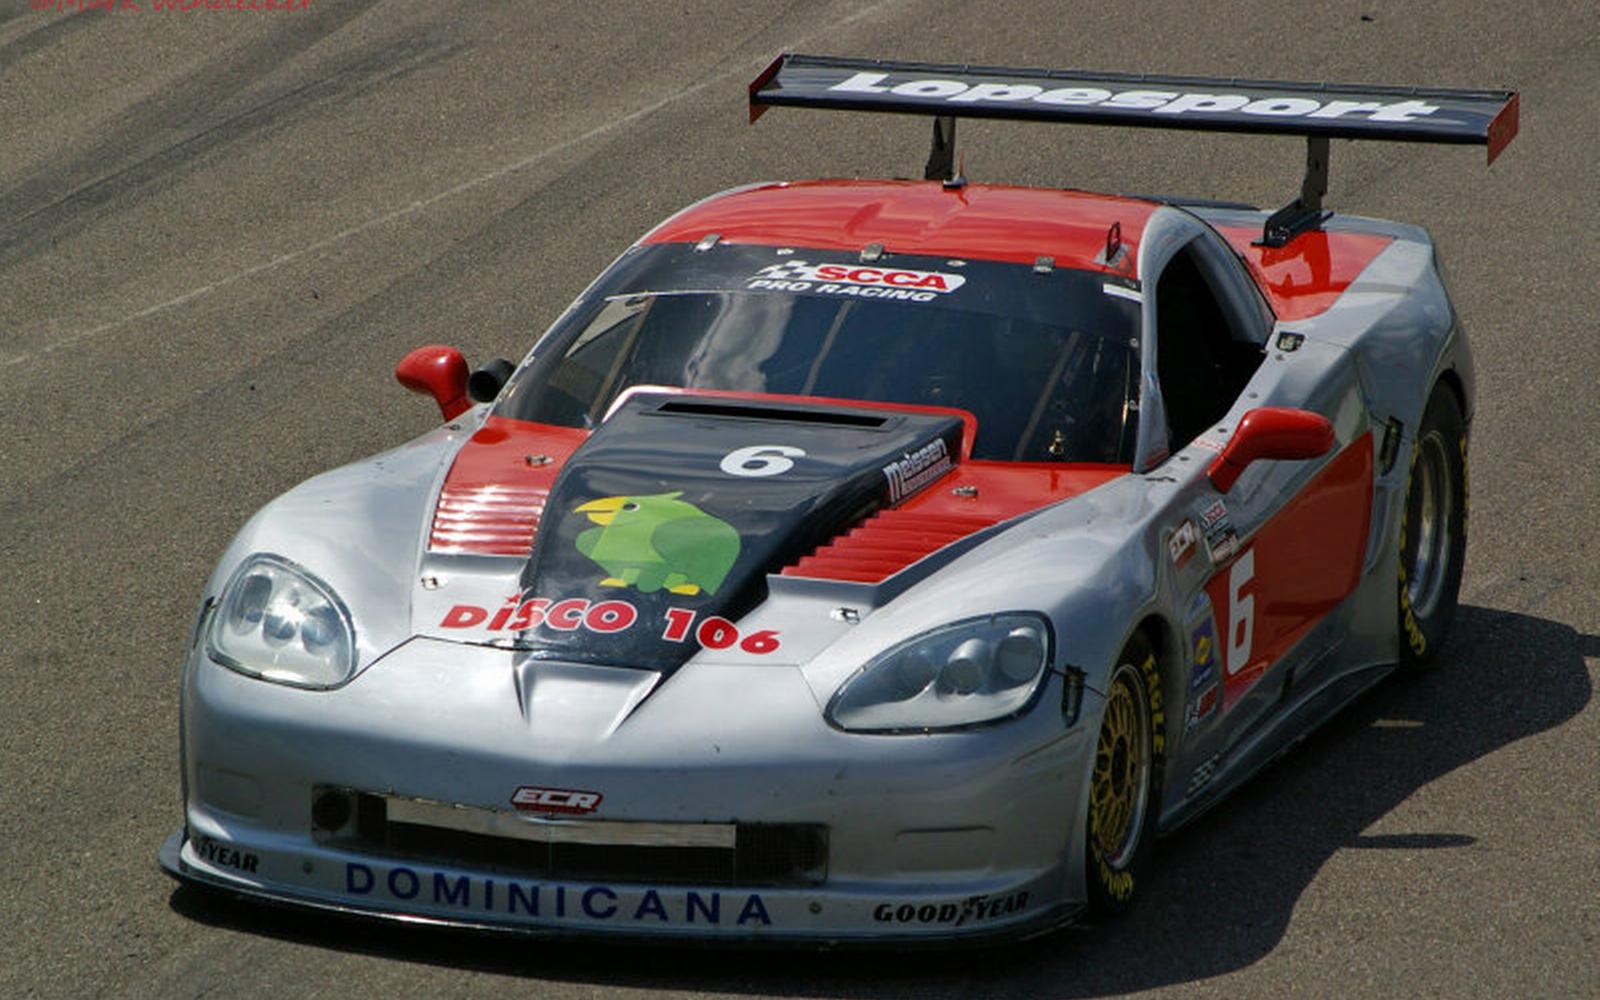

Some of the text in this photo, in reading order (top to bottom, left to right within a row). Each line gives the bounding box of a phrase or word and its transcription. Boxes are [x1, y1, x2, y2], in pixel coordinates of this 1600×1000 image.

[829, 71, 1441, 123] Lopesport
[746, 280, 939, 302] PRO RACING
[814, 266, 949, 291] SCCA
[720, 445, 806, 478] 6
[662, 608, 782, 655] 106
[1227, 547, 1255, 676] 6
[511, 787, 599, 809] ECR
[346, 863, 772, 925] DOMINICANA
